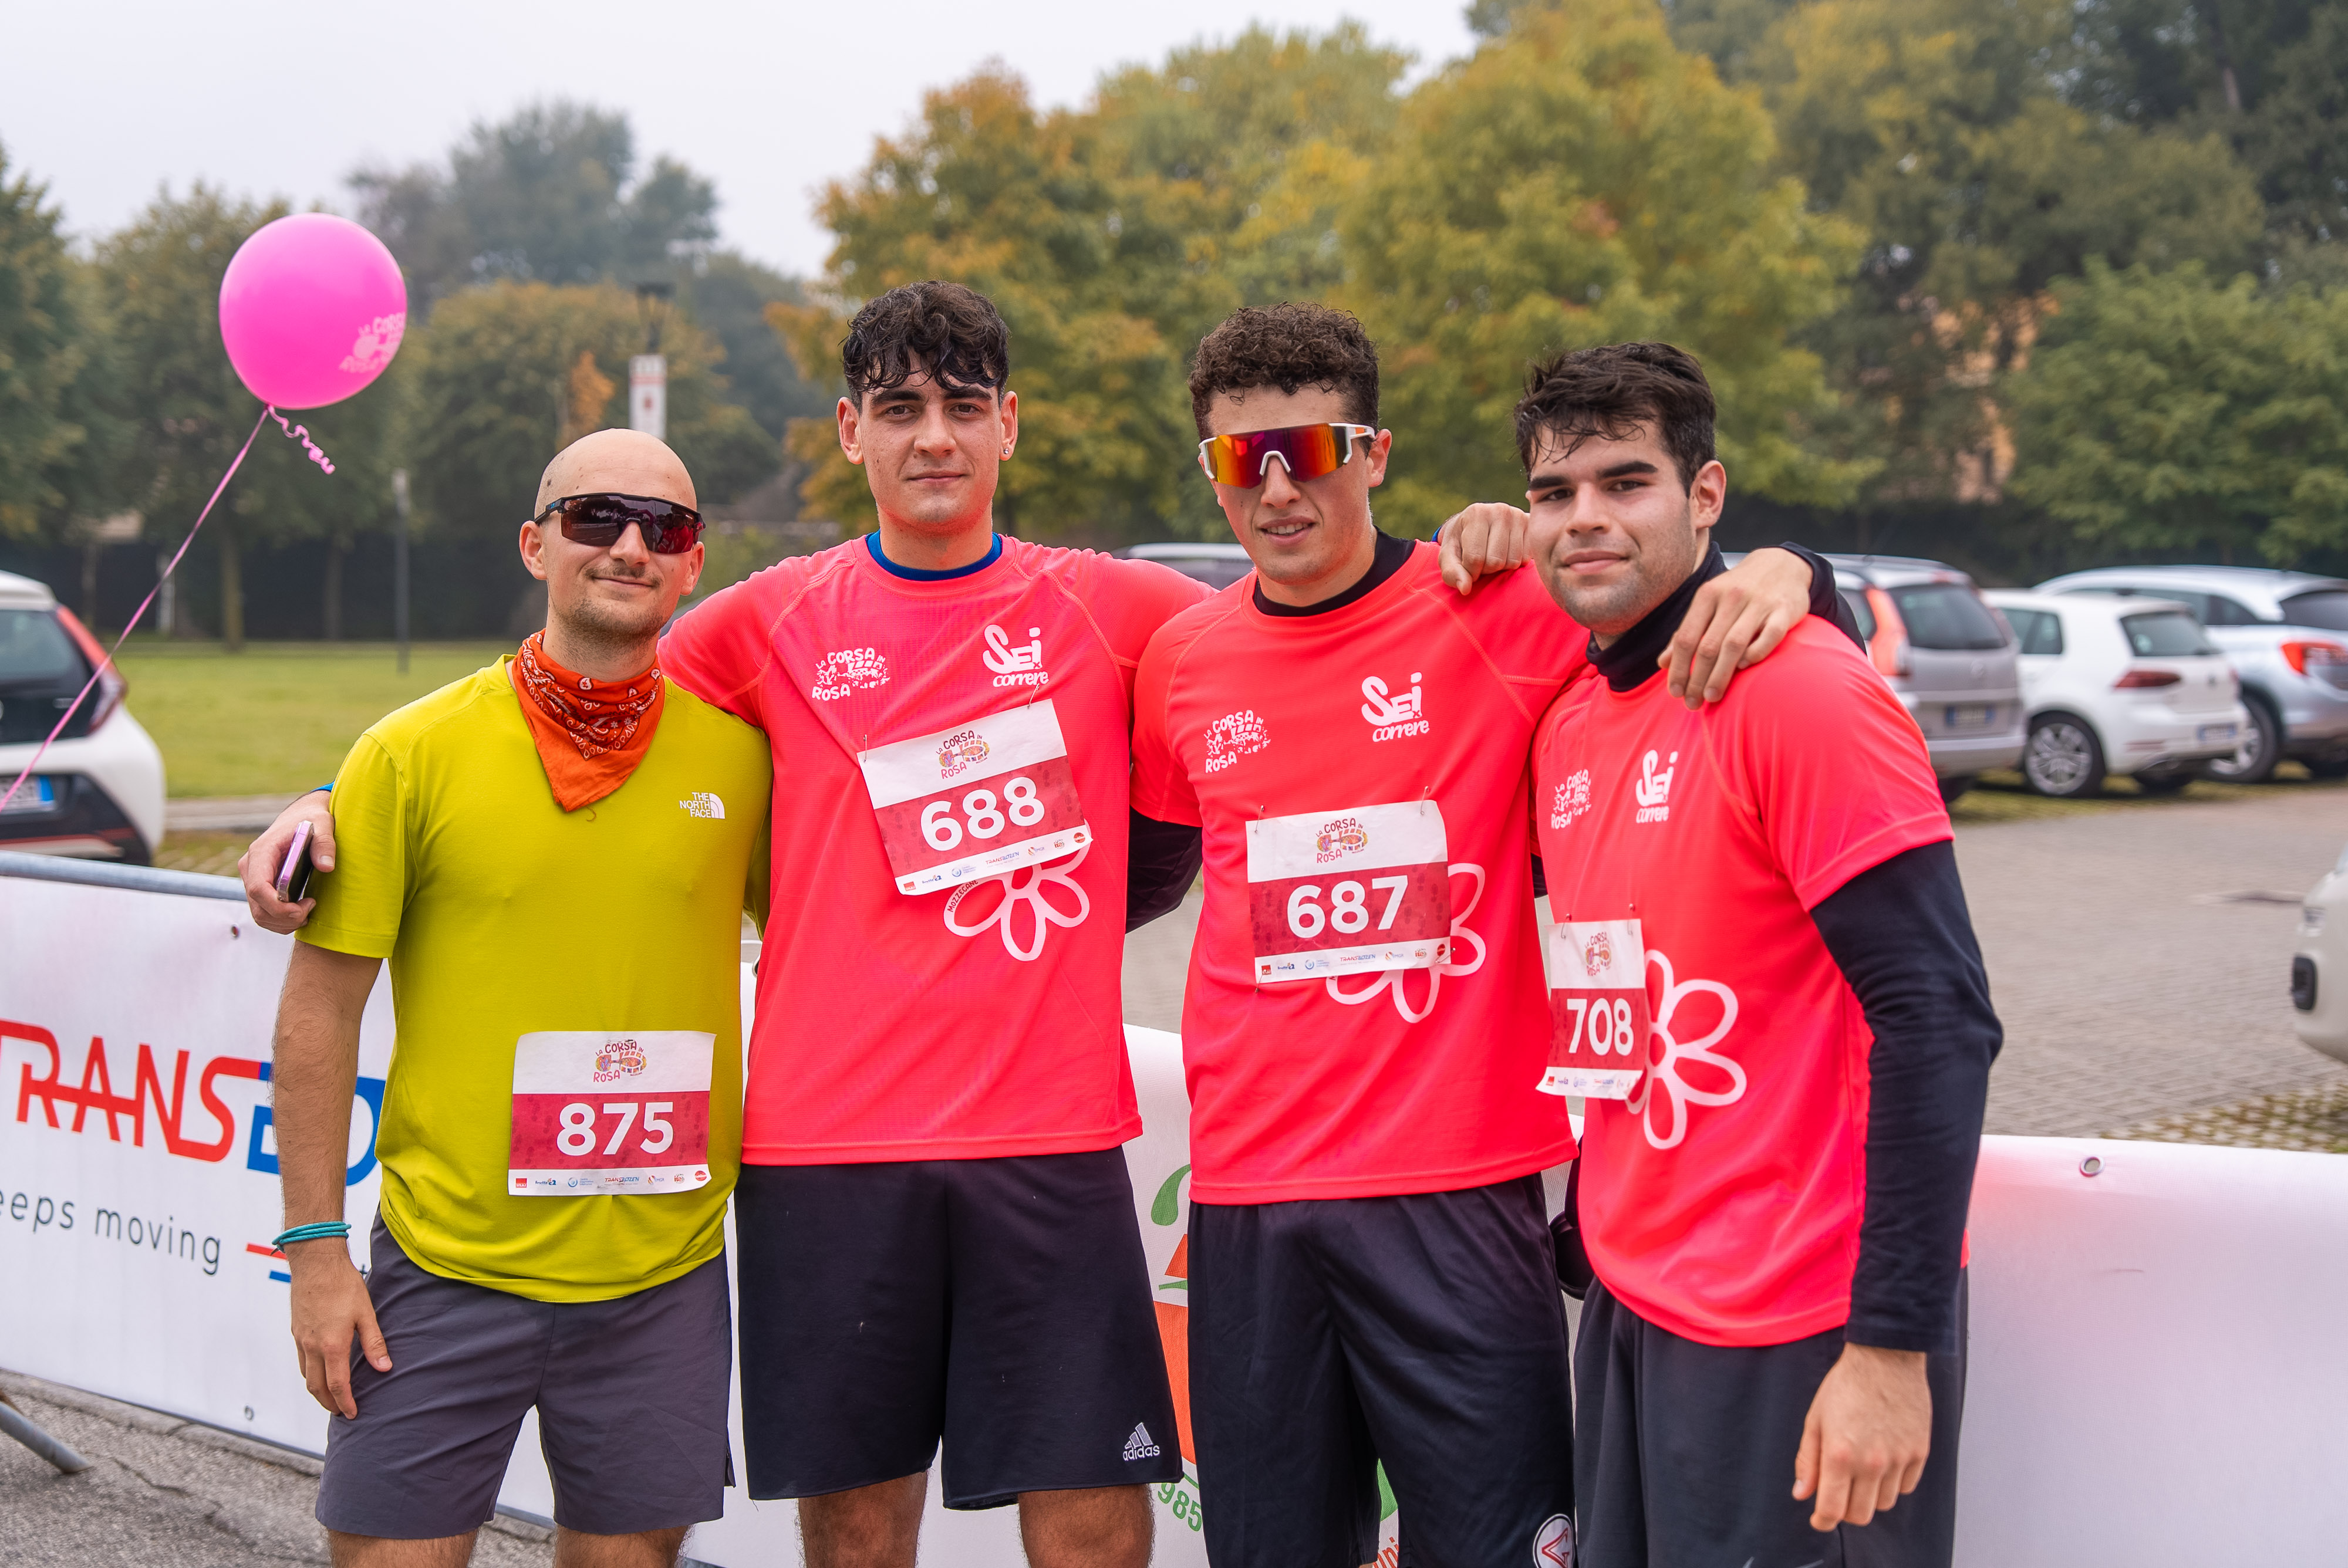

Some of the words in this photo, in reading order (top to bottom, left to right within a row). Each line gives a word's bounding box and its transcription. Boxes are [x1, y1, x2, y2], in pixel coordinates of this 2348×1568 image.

[373, 312, 406, 333] CORS
[815, 660, 826, 669] LA
[827, 647, 875, 665] CORSA
[877, 655, 886, 663] IN
[993, 671, 1050, 687] correre
[812, 684, 851, 701] ROSA
[1204, 729, 1212, 739] LA
[1212, 709, 1254, 734] CORSA
[1256, 717, 1264, 725] IN
[1372, 720, 1430, 742] correre
[943, 730, 975, 749] CORSA
[941, 761, 967, 779] ROSA
[1205, 751, 1237, 773] ROSA
[679, 800, 710, 809] NORTH
[691, 792, 709, 801] THE
[690, 809, 711, 818] FACE
[920, 776, 1045, 851] 688
[1551, 810, 1572, 829] ROSA
[1324, 817, 1356, 833] CORSA
[1317, 849, 1342, 863] ROSA
[947, 880, 979, 913] MOZZECANE
[1287, 874, 1408, 939] 687
[1567, 998, 1634, 1056] 708
[605, 1040, 637, 1054] CORSA
[593, 1070, 620, 1082] ROSA
[556, 1101, 674, 1156] 875
[0, 1189, 75, 1234] eps
[95, 1206, 221, 1276] moving
[1122, 1445, 1160, 1461] adidas
[1158, 1482, 1203, 1532] 985
